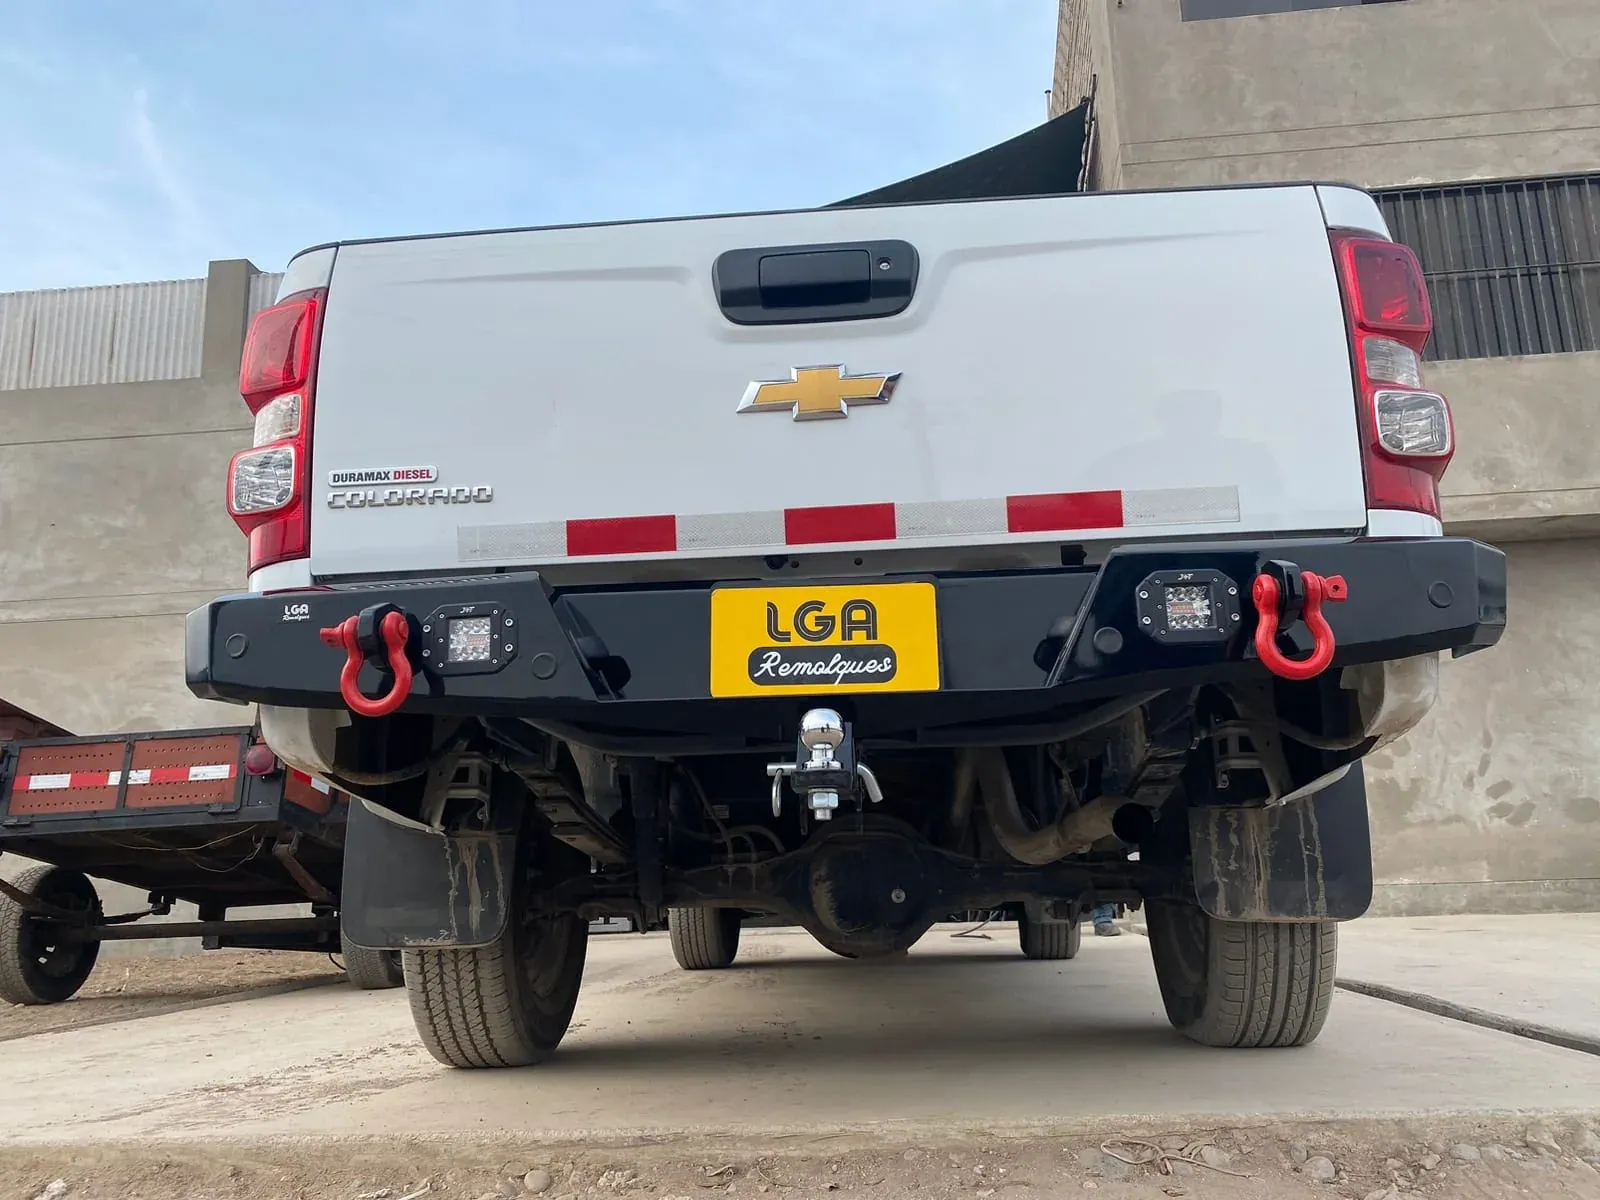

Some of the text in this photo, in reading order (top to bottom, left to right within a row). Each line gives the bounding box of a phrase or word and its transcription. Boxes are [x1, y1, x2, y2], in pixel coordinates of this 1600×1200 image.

[332, 468, 433, 483] DURAMAX DIESEL
[327, 485, 493, 509] COLORADO
[284, 603, 309, 615] LGA
[766, 598, 878, 643] LGA
[753, 651, 893, 686] Remolques
